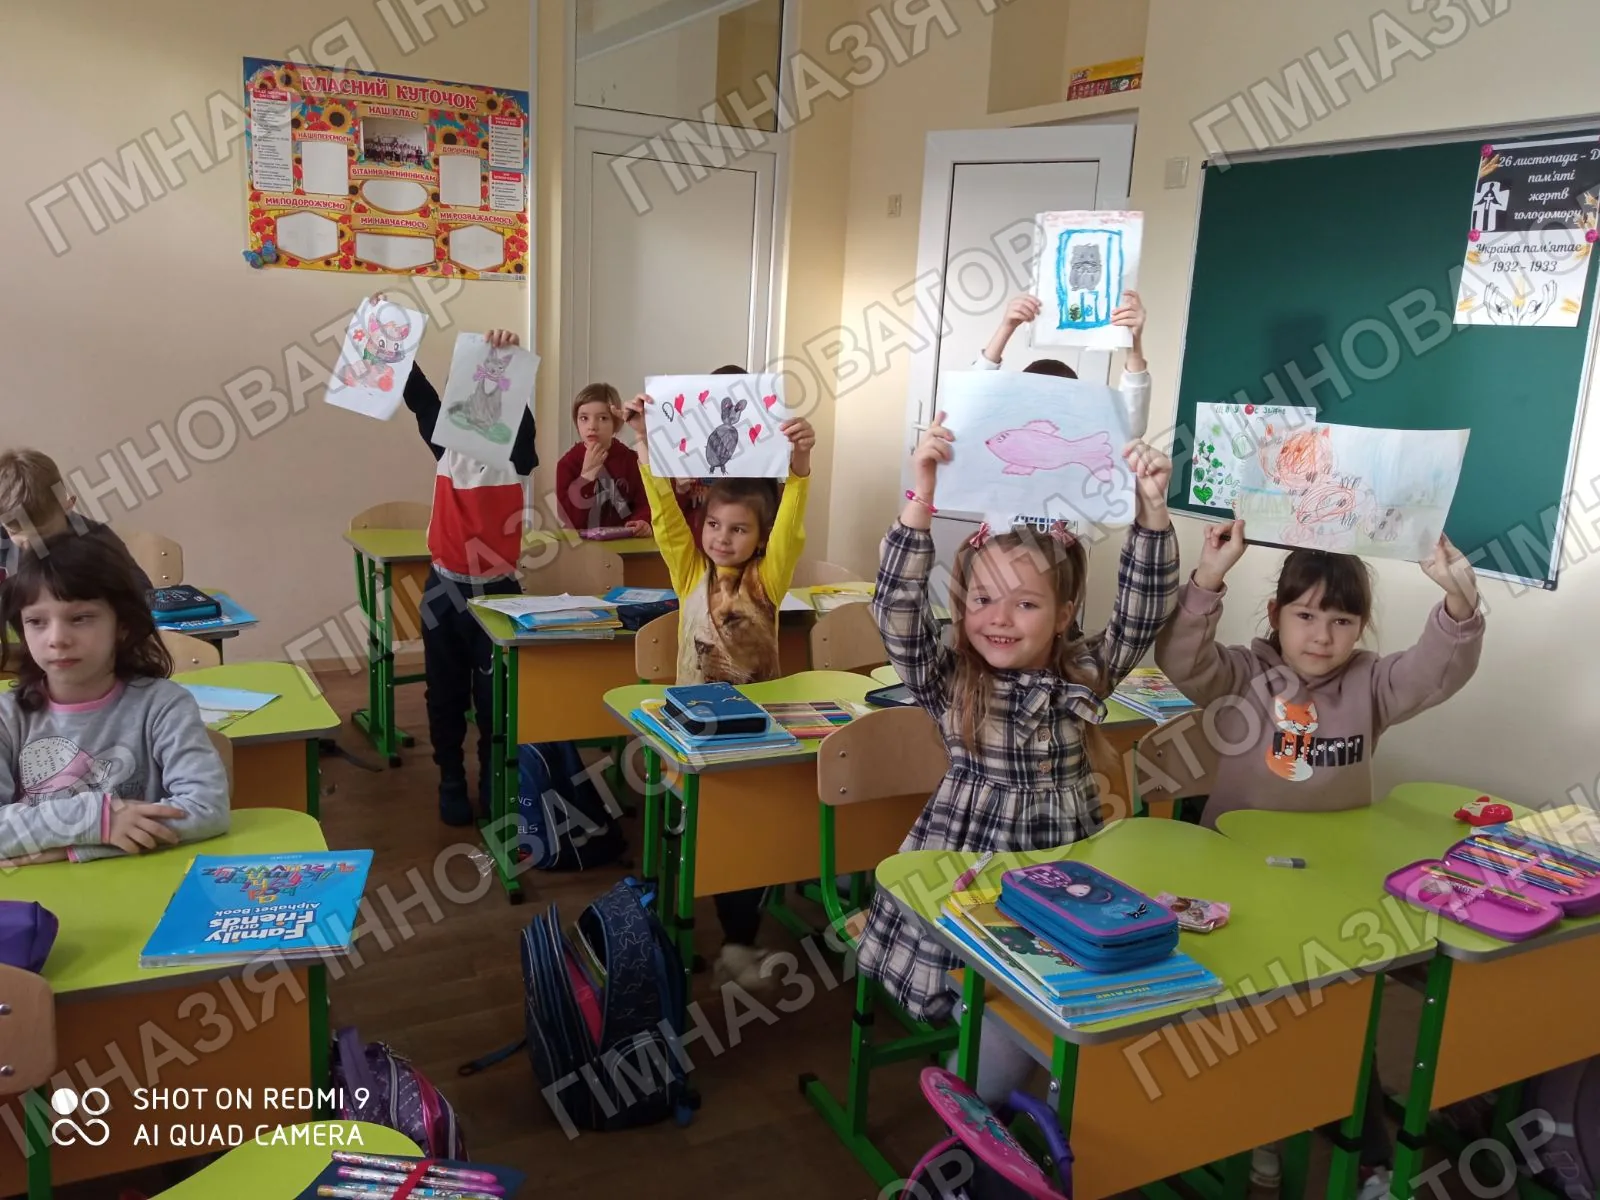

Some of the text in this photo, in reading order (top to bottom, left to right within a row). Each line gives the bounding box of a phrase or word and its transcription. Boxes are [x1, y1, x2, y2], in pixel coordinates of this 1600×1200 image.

[301, 75, 478, 110] КЛАСНИЙ КУТОЧОК
[368, 106, 418, 118] НАШ КЛАС
[1499, 156, 1512, 167] 26
[1513, 152, 1578, 167] листопада
[265, 197, 279, 205] МИ
[1528, 187, 1570, 205] жертв
[1514, 209, 1582, 223] голодомору
[1476, 243, 1520, 255] Україна
[1492, 261, 1518, 272] 1932
[1530, 261, 1558, 272] 1933
[215, 901, 321, 916] Alphabet Book
[209, 910, 315, 929] Friends
[204, 923, 306, 944] Family
[229, 923, 260, 932] and
